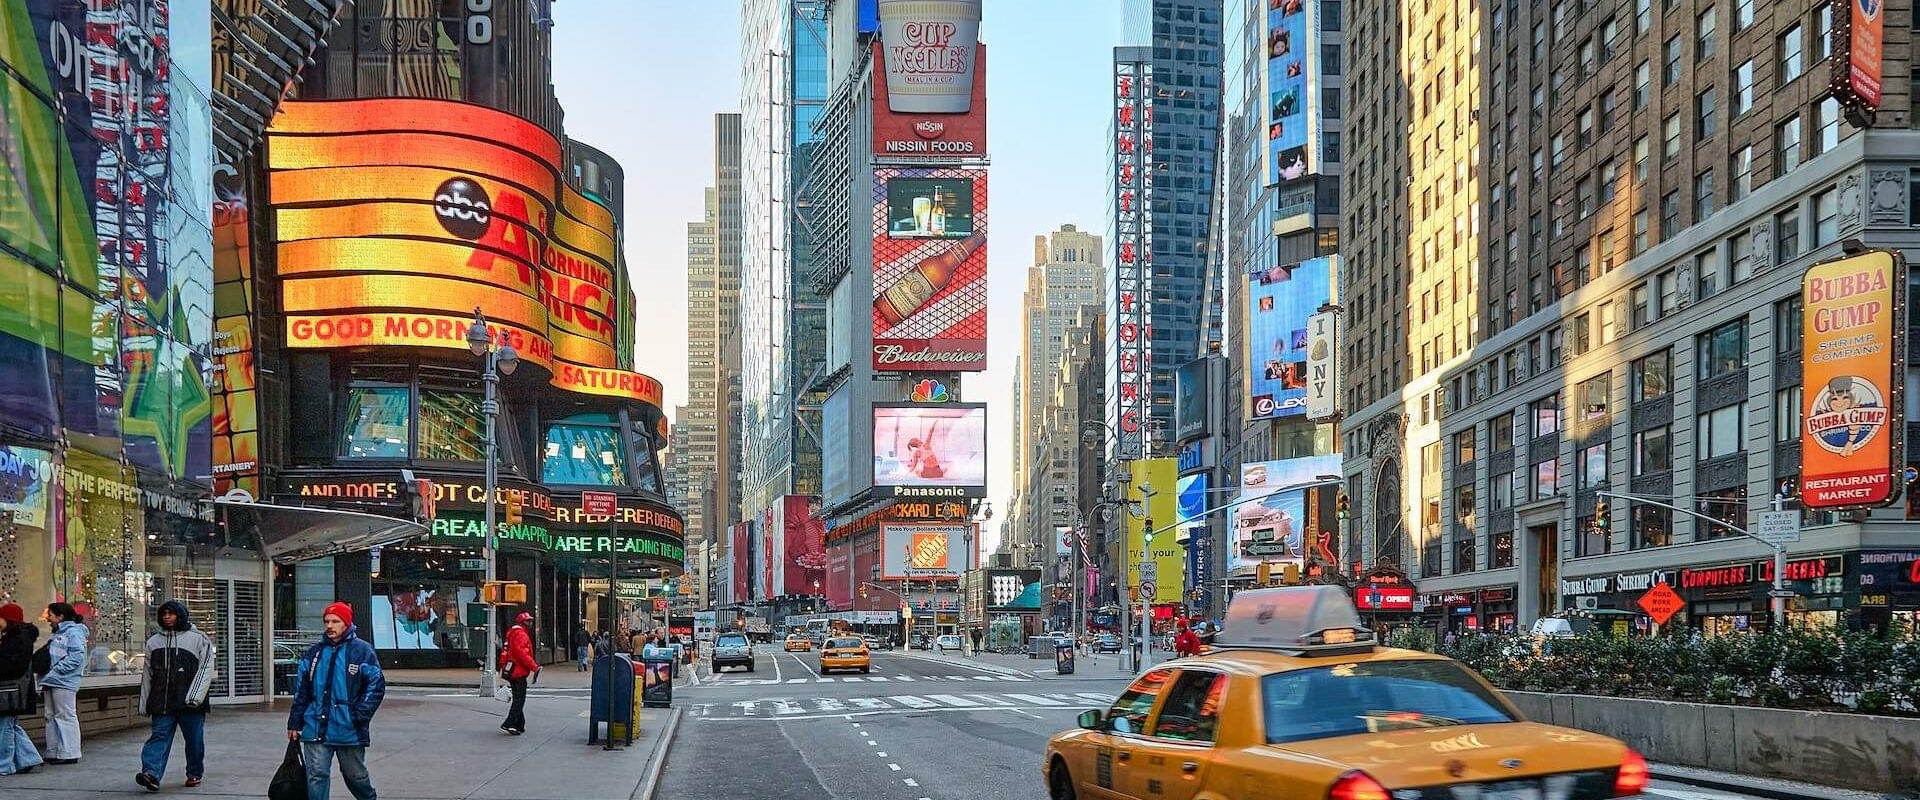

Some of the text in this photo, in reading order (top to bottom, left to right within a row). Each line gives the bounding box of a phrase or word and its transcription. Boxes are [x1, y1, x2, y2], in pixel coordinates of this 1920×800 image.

[902, 22, 956, 47] CUP
[917, 120, 943, 132] NISSIN
[886, 141, 973, 152] NISSIN FOODS
[434, 192, 489, 226] abc
[544, 246, 609, 289] ORNING
[1809, 267, 1888, 305] BUBBA
[1316, 318, 1325, 336] I
[1814, 300, 1882, 334] GUMP
[292, 317, 374, 340] GOOD
[384, 317, 524, 350] MORNG
[1819, 333, 1875, 350] SHRIMP
[874, 345, 984, 364] Budweiser
[1120, 292, 1137, 433] YOUNG
[1812, 344, 1885, 363] COMPANY
[563, 365, 658, 398] SATURDAY
[1808, 409, 1884, 434] BUBBA GUMP
[1820, 426, 1849, 438] SHRIMP
[71, 468, 95, 494] THE
[97, 476, 143, 505] PERFECT
[145, 490, 164, 511] TOY
[894, 486, 965, 497] Panasonic
[1805, 474, 1887, 490] RESTAURANT
[431, 483, 462, 502] OT
[1818, 488, 1873, 501] MARKET
[555, 536, 592, 552] ARE
[597, 536, 659, 556] READING
[913, 533, 947, 568] HOME
[1153, 550, 1174, 560] your
[1562, 580, 1585, 596] BUBBA
[1585, 577, 1608, 594] GUMP
[1616, 573, 1650, 591] SHRIMP
[1681, 566, 1745, 589] COMPUTERS
[1652, 590, 1672, 598] ROAD
